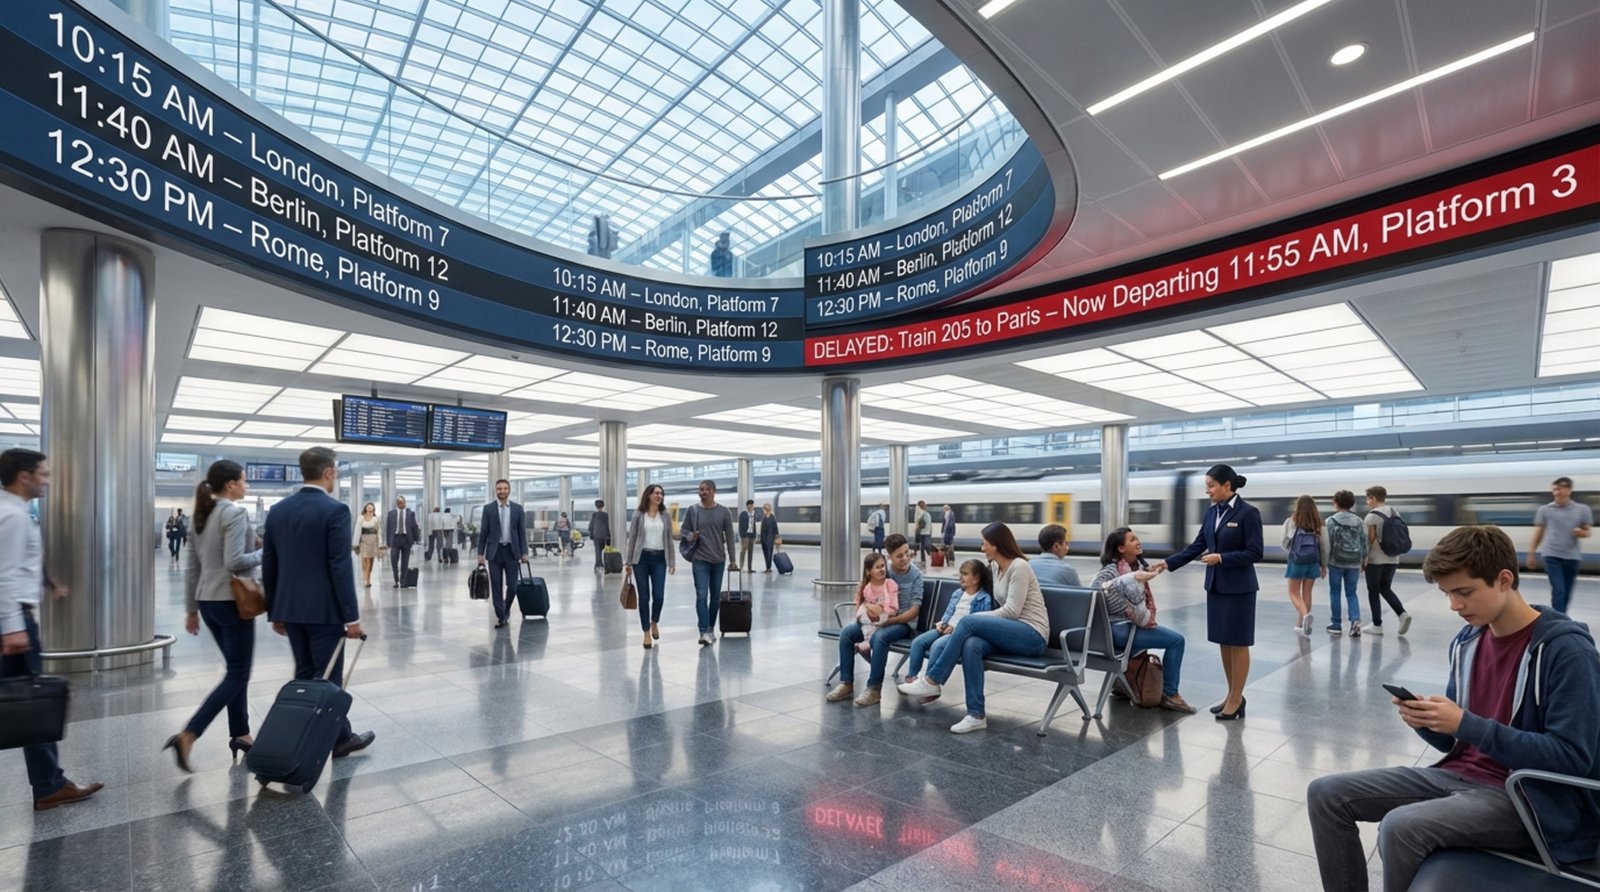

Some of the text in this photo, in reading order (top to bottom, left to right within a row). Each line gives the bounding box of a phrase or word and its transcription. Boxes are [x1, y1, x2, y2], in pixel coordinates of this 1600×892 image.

[48, 71, 152, 150] 11:40
[162, 134, 215, 183] AM
[251, 176, 327, 238] Berlin,
[336, 217, 420, 271] Platform
[427, 256, 449, 281] 12
[49, 12, 152, 98] 10:15
[162, 84, 215, 137] AM
[251, 132, 345, 207] London,
[353, 186, 433, 243] Platform
[439, 226, 450, 247] 7
[48, 130, 152, 202] 12:30
[164, 181, 215, 230] PM
[251, 220, 330, 279] Rome,
[338, 257, 422, 306] Platform
[428, 289, 440, 310] 9
[814, 334, 894, 359] DELAYED:
[898, 328, 936, 349] Train
[941, 319, 971, 343] 205
[975, 319, 992, 336] to
[997, 306, 1041, 332] Paris
[1063, 294, 1107, 319] Now
[1113, 266, 1219, 307] Departing
[1229, 240, 1300, 280] 11:55
[1308, 224, 1369, 262] AM,
[1381, 182, 1535, 244] Platform
[1551, 164, 1578, 198] 3
[817, 247, 855, 268] 10:15
[857, 240, 880, 262] AM
[952, 183, 1003, 228] Platform
[1005, 168, 1013, 191] 7
[817, 272, 855, 293] 11:40
[857, 266, 880, 287] AM
[998, 203, 1013, 229] 12
[552, 295, 596, 320] 11:40
[600, 306, 626, 326] AM
[645, 313, 691, 336] Berlin,
[696, 319, 755, 338] Platform
[760, 321, 778, 338] 12
[553, 267, 596, 293] 10:15
[600, 279, 626, 300] AM
[645, 287, 702, 312] London,
[707, 294, 766, 312] Platform
[770, 297, 779, 312] 7
[817, 296, 855, 317] 12:30
[858, 291, 881, 311] PM
[944, 250, 997, 288] Platform
[1000, 239, 1008, 260] 9
[552, 323, 596, 348] 12:30
[601, 332, 626, 353] PM
[645, 339, 693, 362] Rome,
[698, 344, 757, 362] Platform
[761, 346, 771, 363] 9
